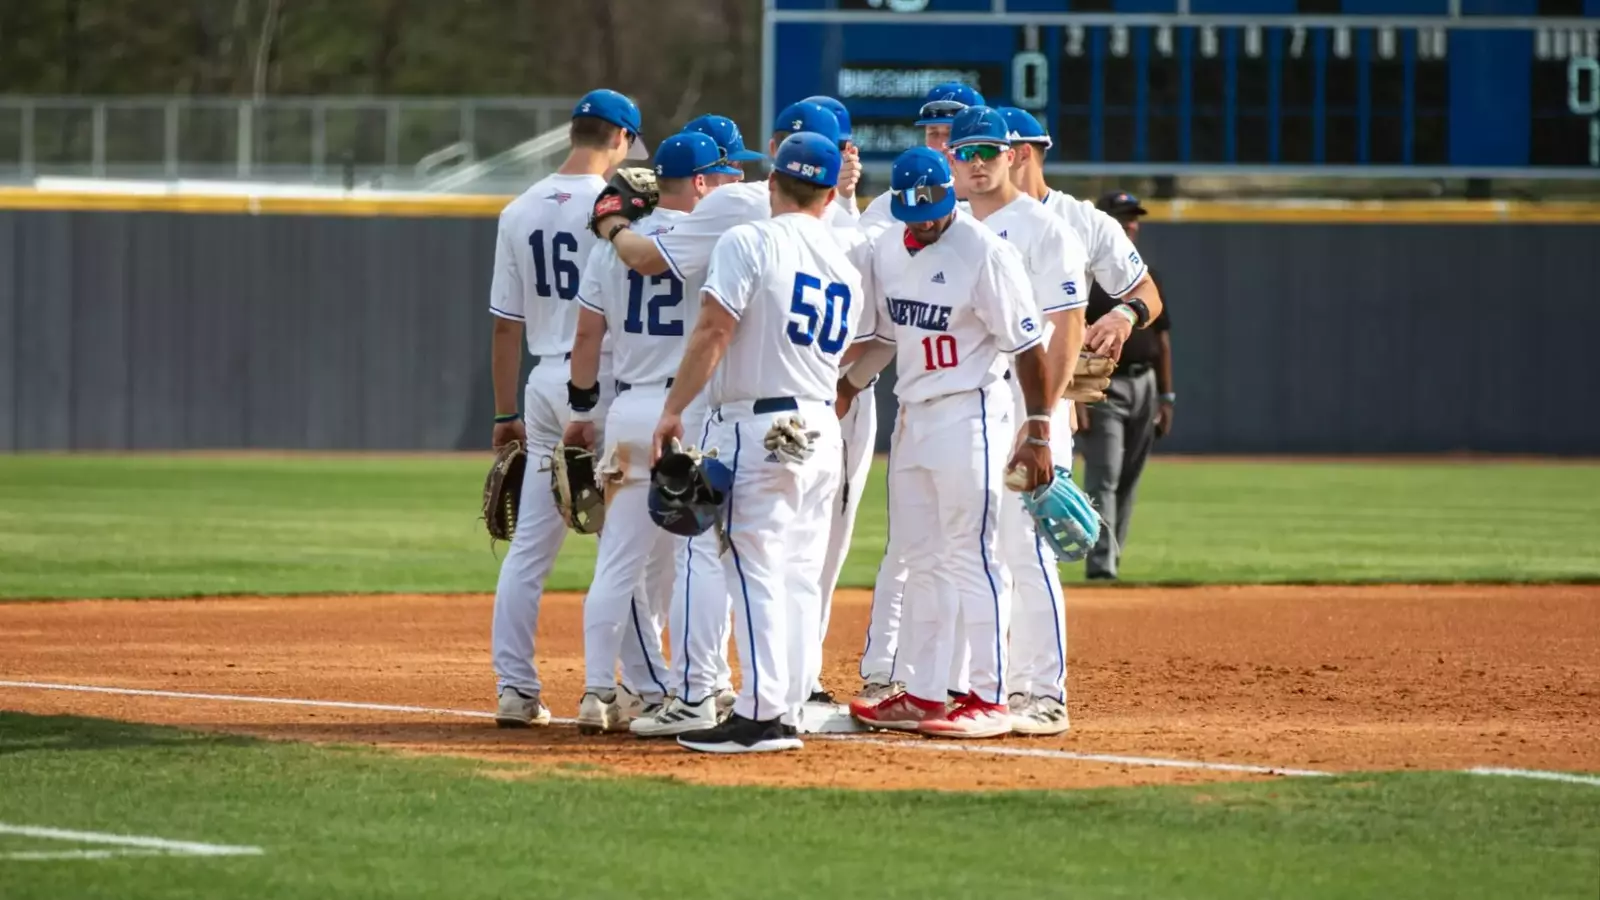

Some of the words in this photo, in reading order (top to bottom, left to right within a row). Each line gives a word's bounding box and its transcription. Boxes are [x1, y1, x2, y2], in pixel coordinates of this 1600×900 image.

[1065, 26, 1084, 57] 2
[1109, 26, 1130, 57] 3
[1154, 26, 1174, 57] 4
[1289, 28, 1308, 58] 7
[1012, 51, 1048, 109] 0
[1567, 56, 1600, 114] 0
[801, 164, 815, 177] 50
[528, 229, 580, 301] 16
[624, 268, 685, 337] 12
[786, 271, 852, 354] 50
[921, 335, 958, 371] 10
